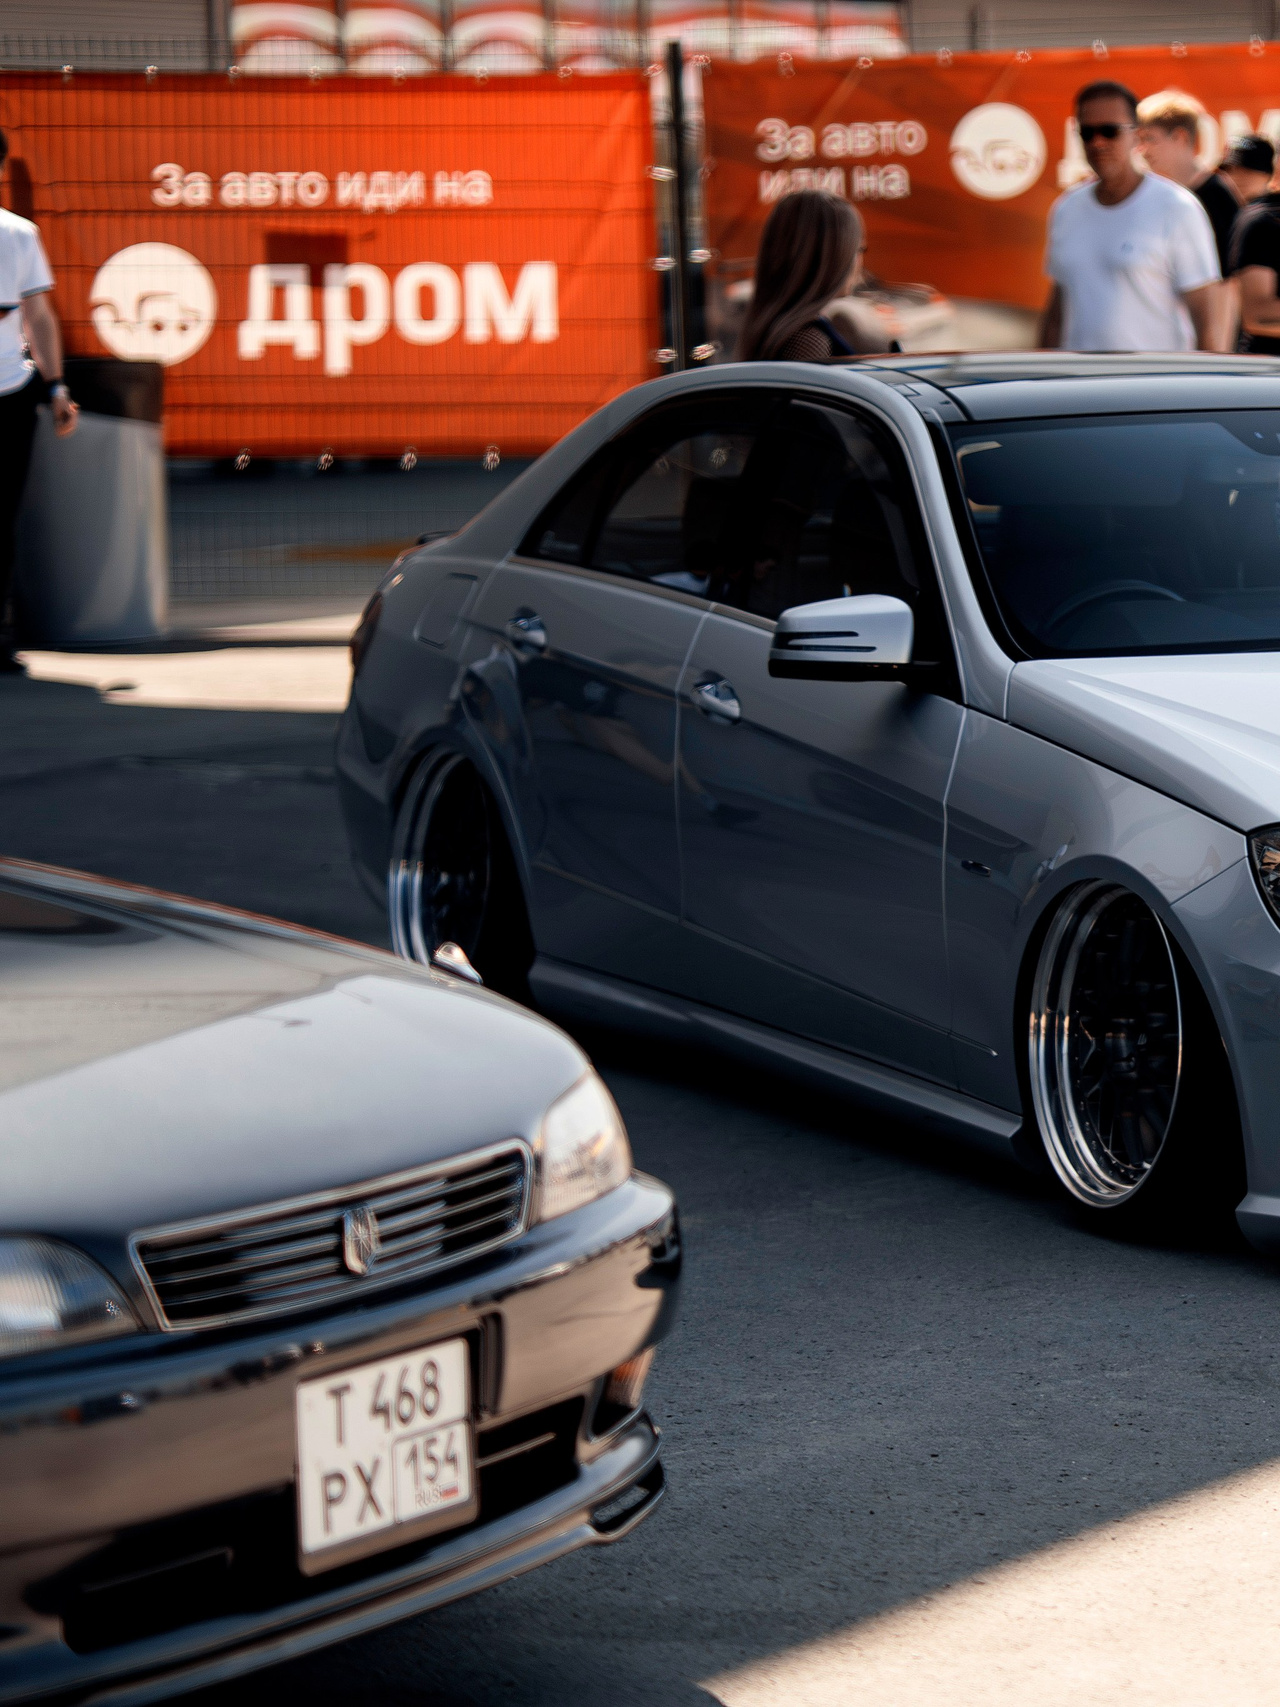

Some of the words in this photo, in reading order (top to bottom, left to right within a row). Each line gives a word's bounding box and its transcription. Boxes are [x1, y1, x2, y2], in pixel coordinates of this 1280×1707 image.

[755, 117, 817, 163] За
[821, 120, 928, 159] авто
[152, 163, 211, 207] За
[219, 171, 329, 207] авто
[335, 170, 426, 213] иди
[433, 170, 493, 206] на
[853, 164, 911, 200] на
[237, 261, 558, 376] дром
[369, 1359, 440, 1433] 468
[405, 1431, 460, 1490] 154
